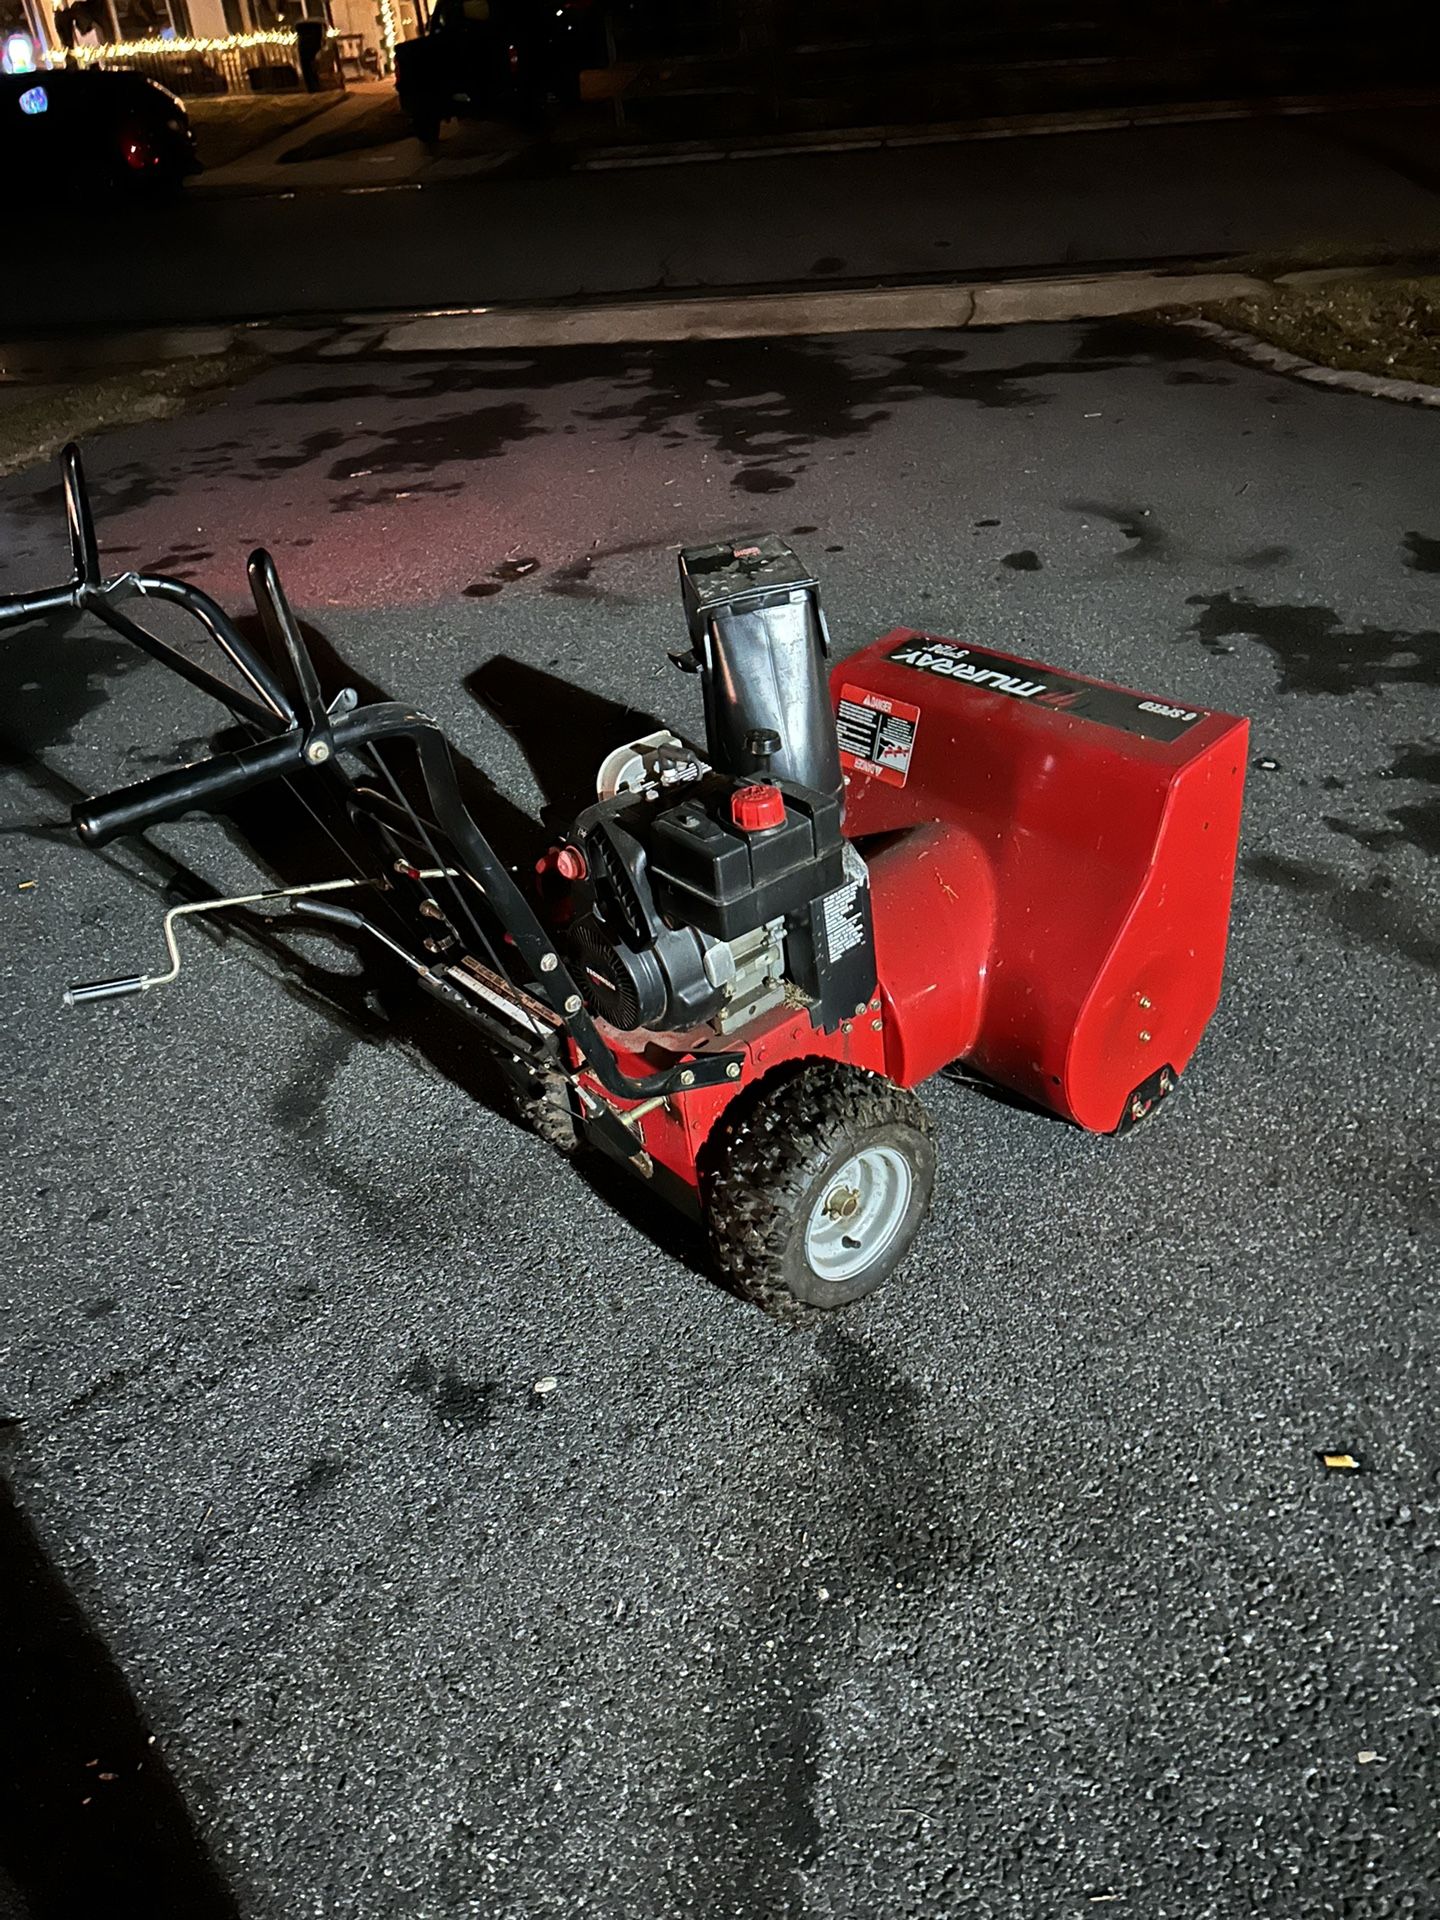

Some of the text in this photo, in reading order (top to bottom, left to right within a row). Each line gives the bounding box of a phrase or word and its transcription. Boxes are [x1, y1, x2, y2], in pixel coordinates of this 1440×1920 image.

[891, 650, 1047, 697] MURRAY
[1138, 701, 1198, 721] 6 SPEED
